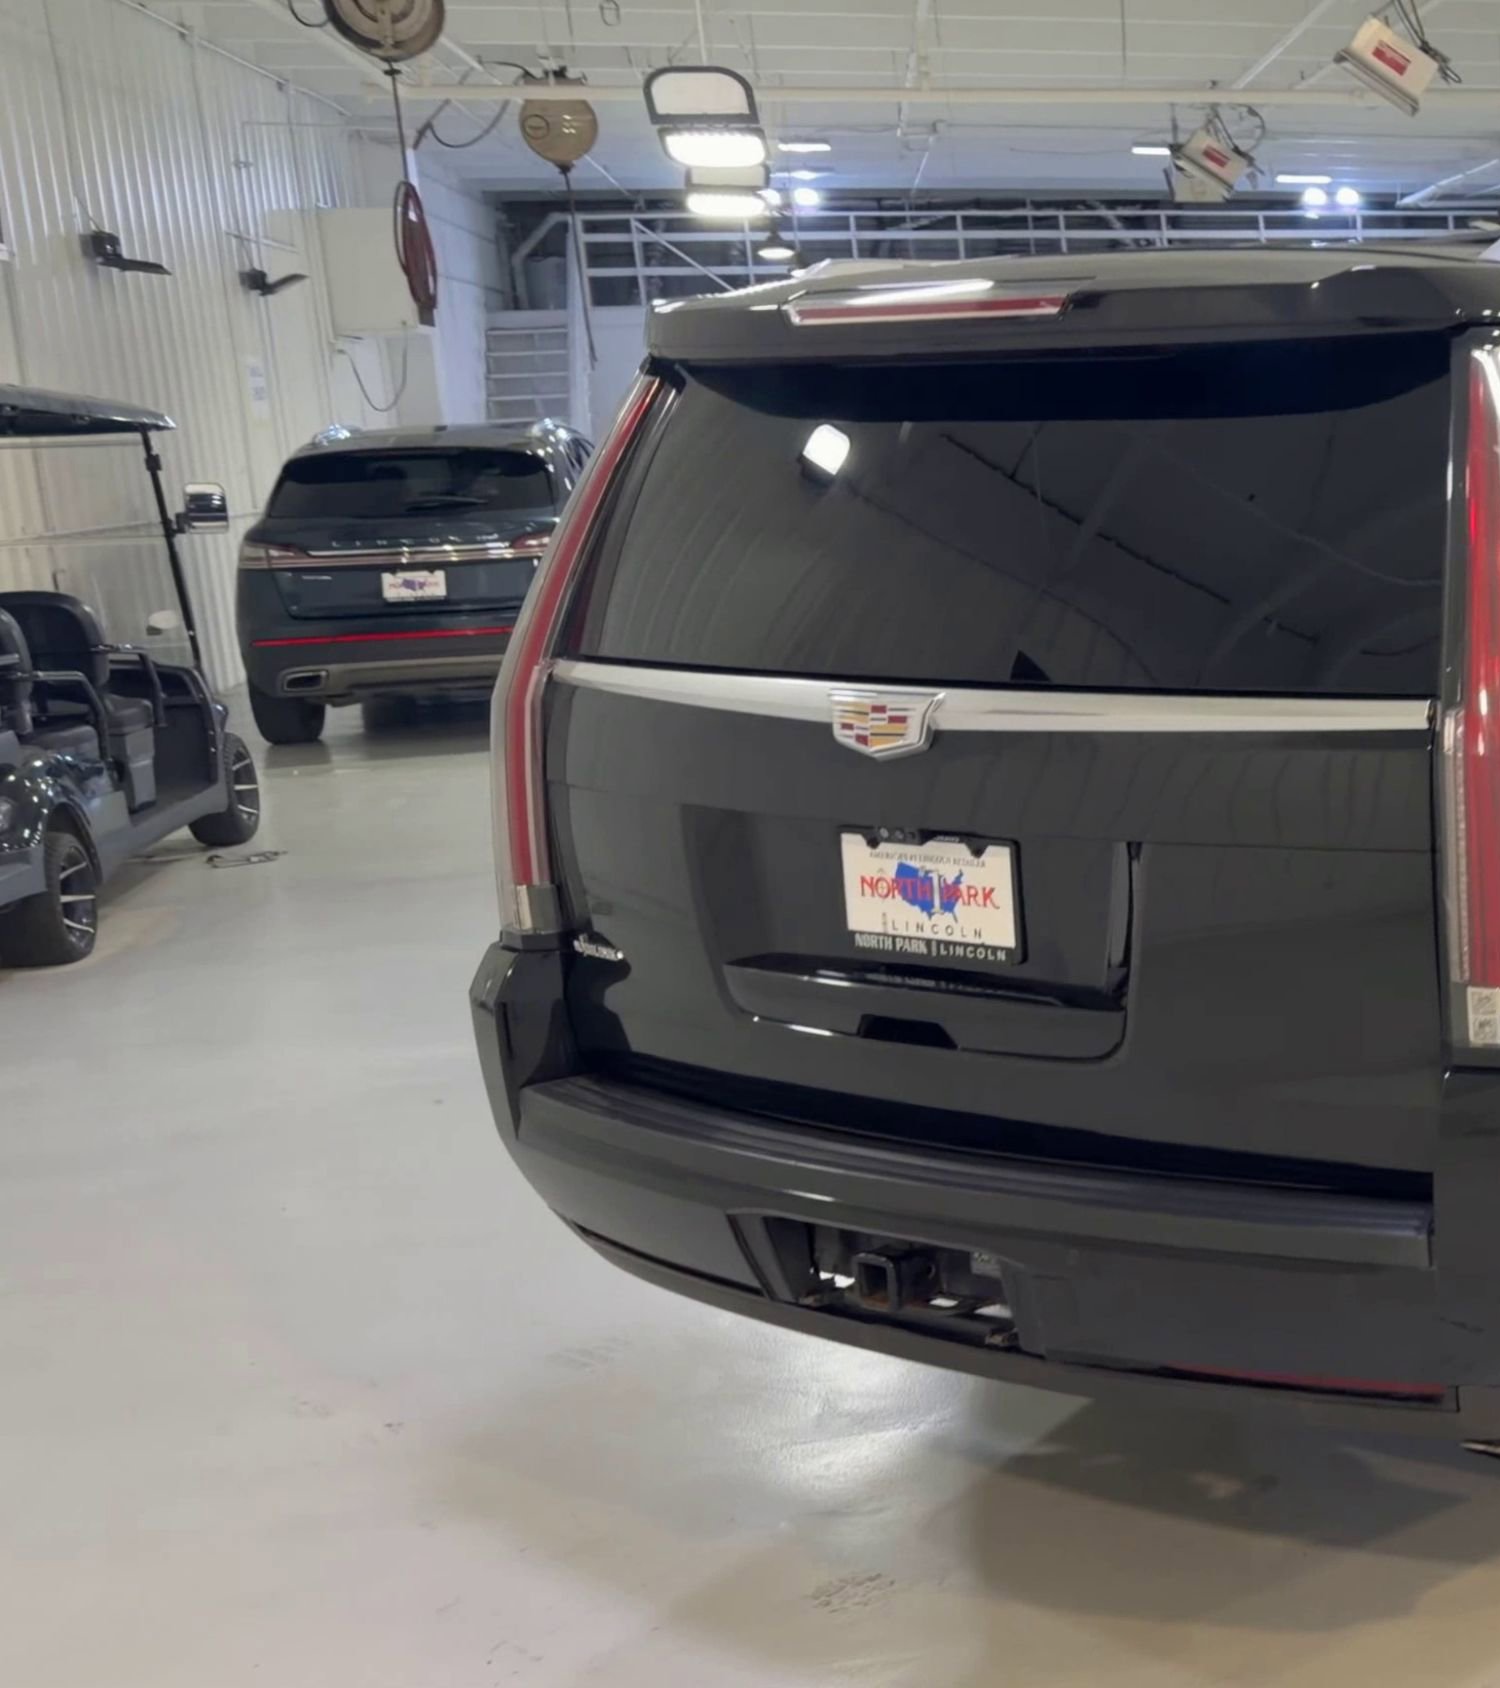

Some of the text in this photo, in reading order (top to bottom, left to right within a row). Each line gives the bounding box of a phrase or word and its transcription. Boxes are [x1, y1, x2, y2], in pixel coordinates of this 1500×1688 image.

[860, 875, 1000, 910] NORTH PARK
[892, 920, 982, 939] LINCOLN
[855, 933, 1007, 961] NORTH PARK LINCOLN
